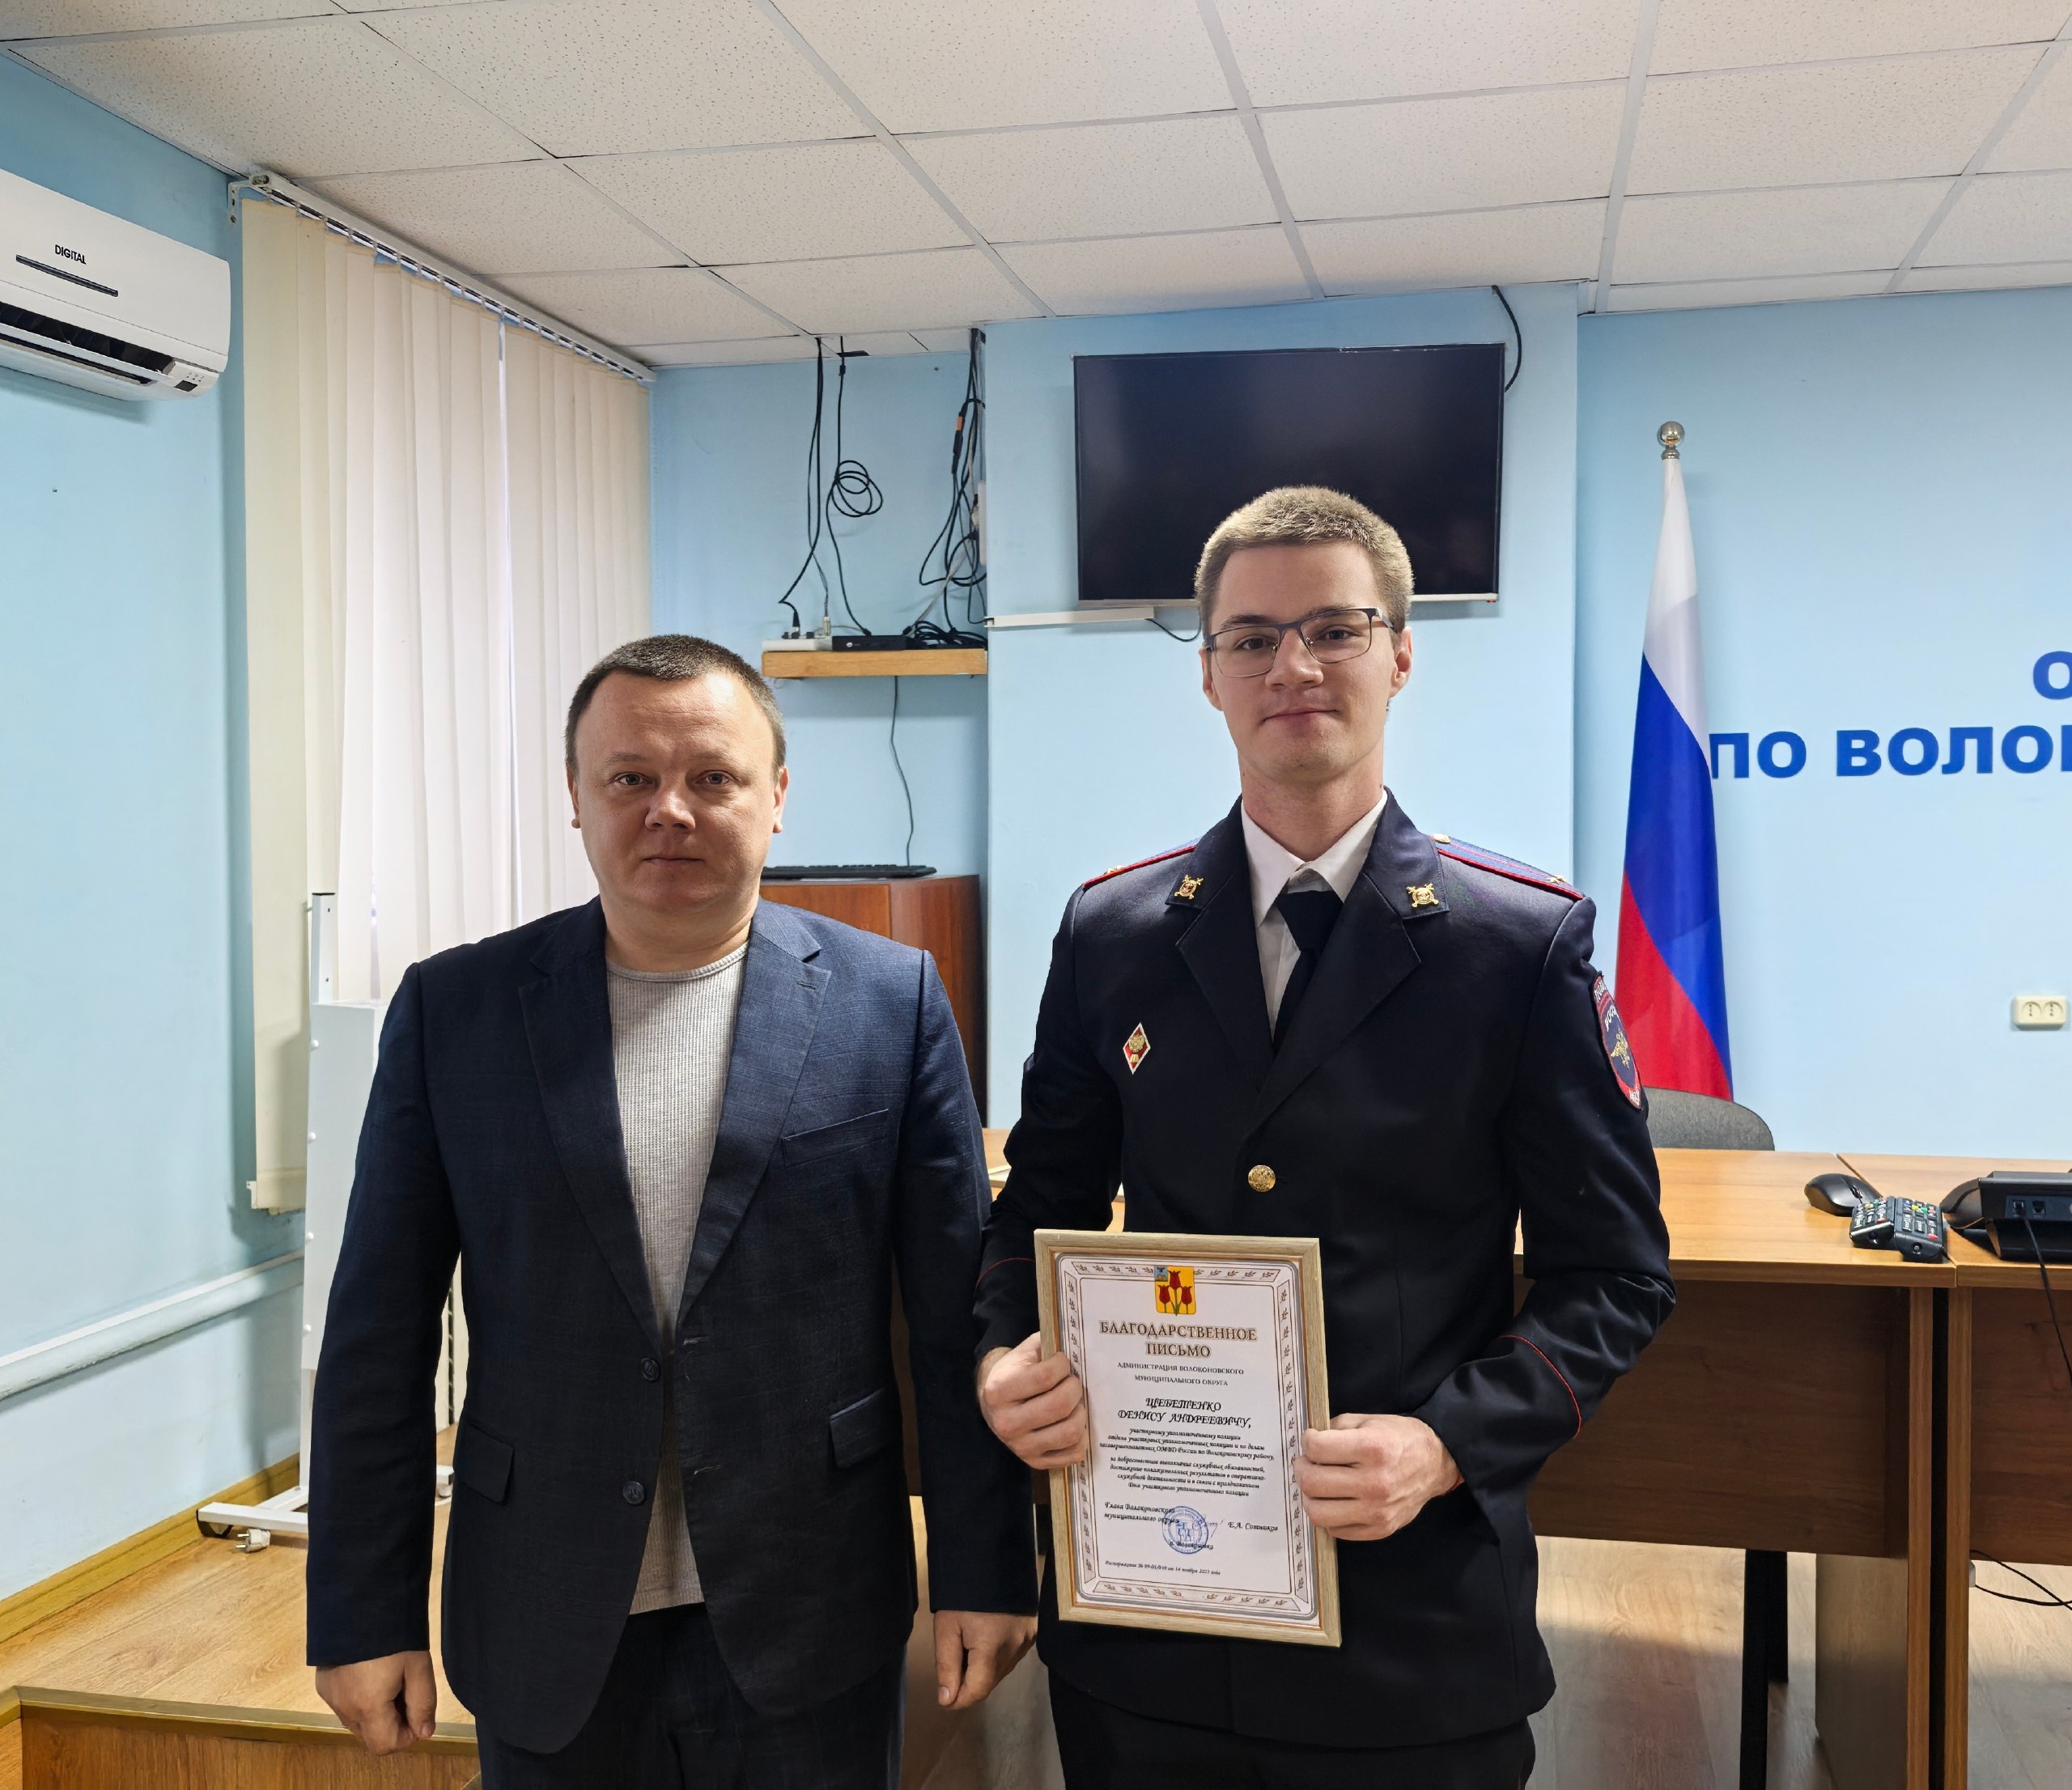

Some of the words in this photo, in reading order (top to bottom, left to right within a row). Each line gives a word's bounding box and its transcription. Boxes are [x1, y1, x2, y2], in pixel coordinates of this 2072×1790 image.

[54, 244, 87, 265] DIGITAL
[1709, 730, 1807, 778] ПО
[1099, 1321, 1257, 1342] БЛАГОДАРСТВЕННОЕ
[1146, 1342, 1211, 1357] ПИСЬМО
[1118, 1362, 1177, 1372] АДМИНИСТРАЦИЯ
[1180, 1366, 1244, 1375] ВОЛОКОНОВСКОГО
[1135, 1375, 1200, 1385] МУНИЦИПАЛЬНОГО
[1118, 1410, 1166, 1423] ДЕНИСУ
[1170, 1415, 1251, 1428] АНДРЕЕВИЧУ,
[1105, 1502, 1123, 1510] Глава
